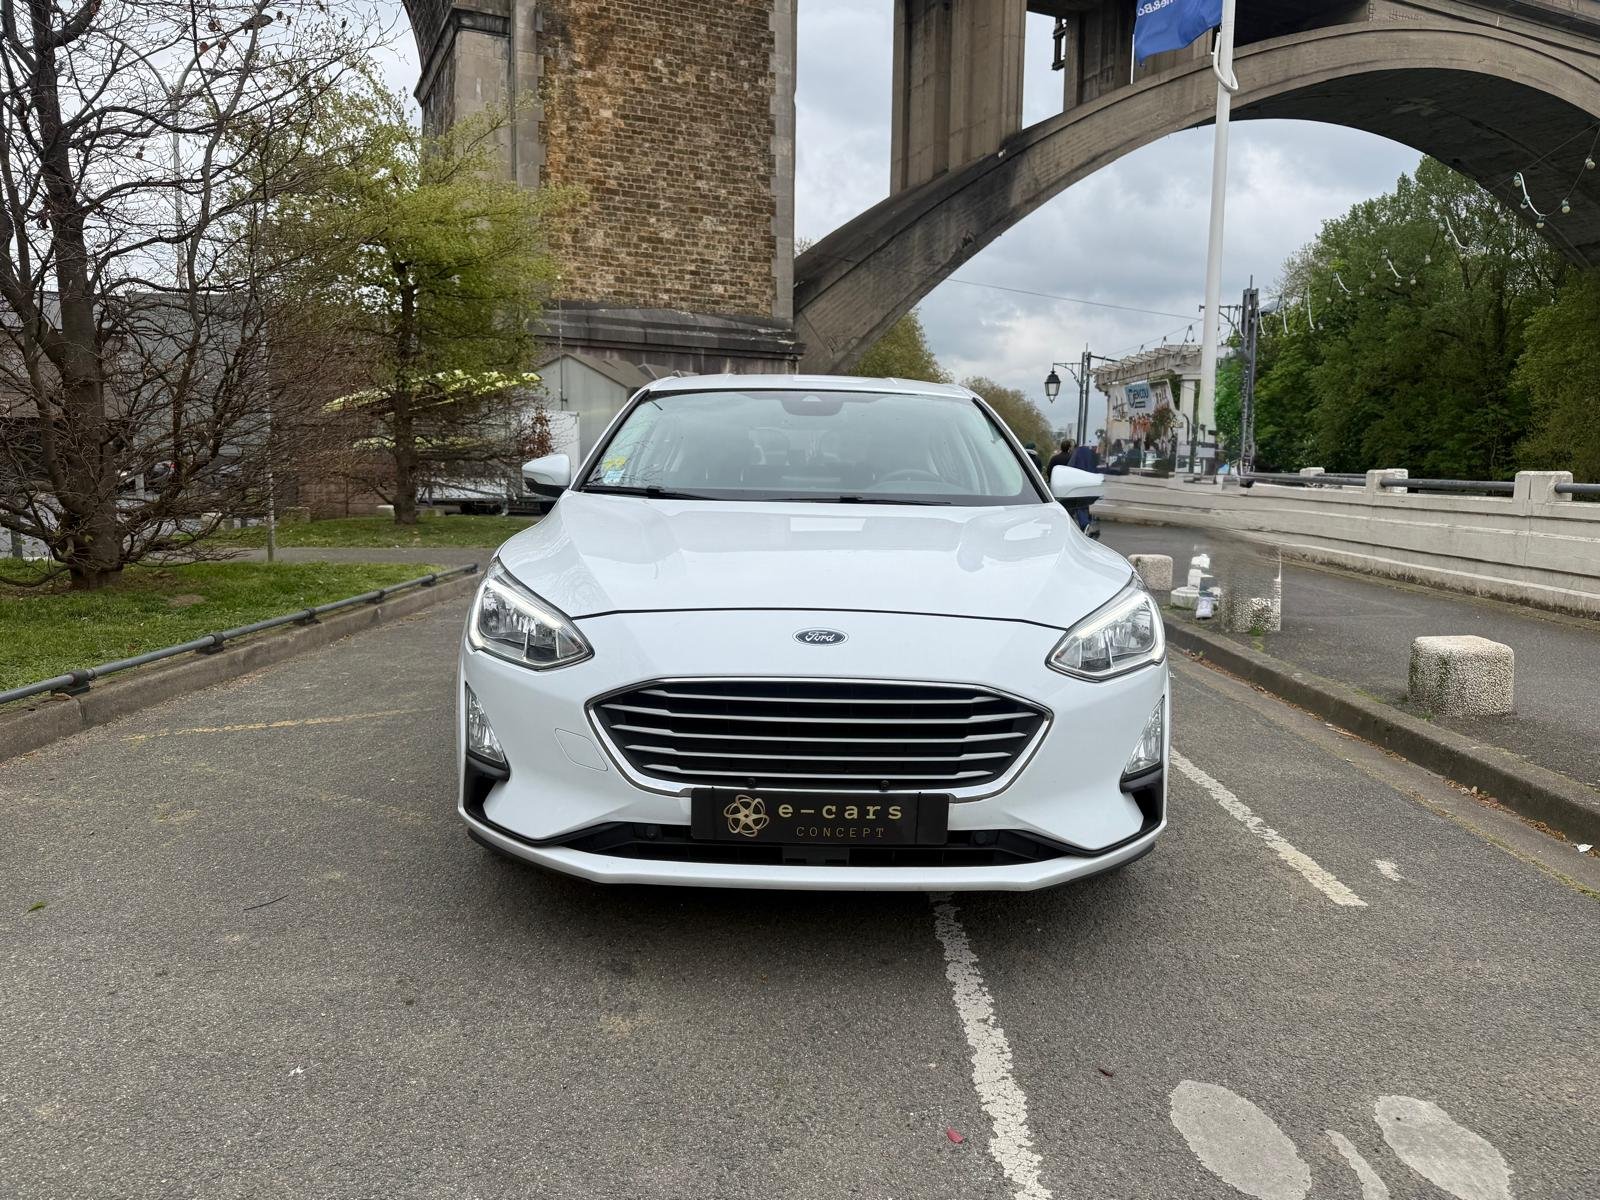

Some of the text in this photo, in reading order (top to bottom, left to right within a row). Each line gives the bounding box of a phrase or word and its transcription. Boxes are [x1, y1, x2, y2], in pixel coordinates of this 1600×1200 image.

[805, 631, 835, 641] Ford
[778, 804, 902, 819] e-cars
[796, 827, 884, 838] CONCEPT
